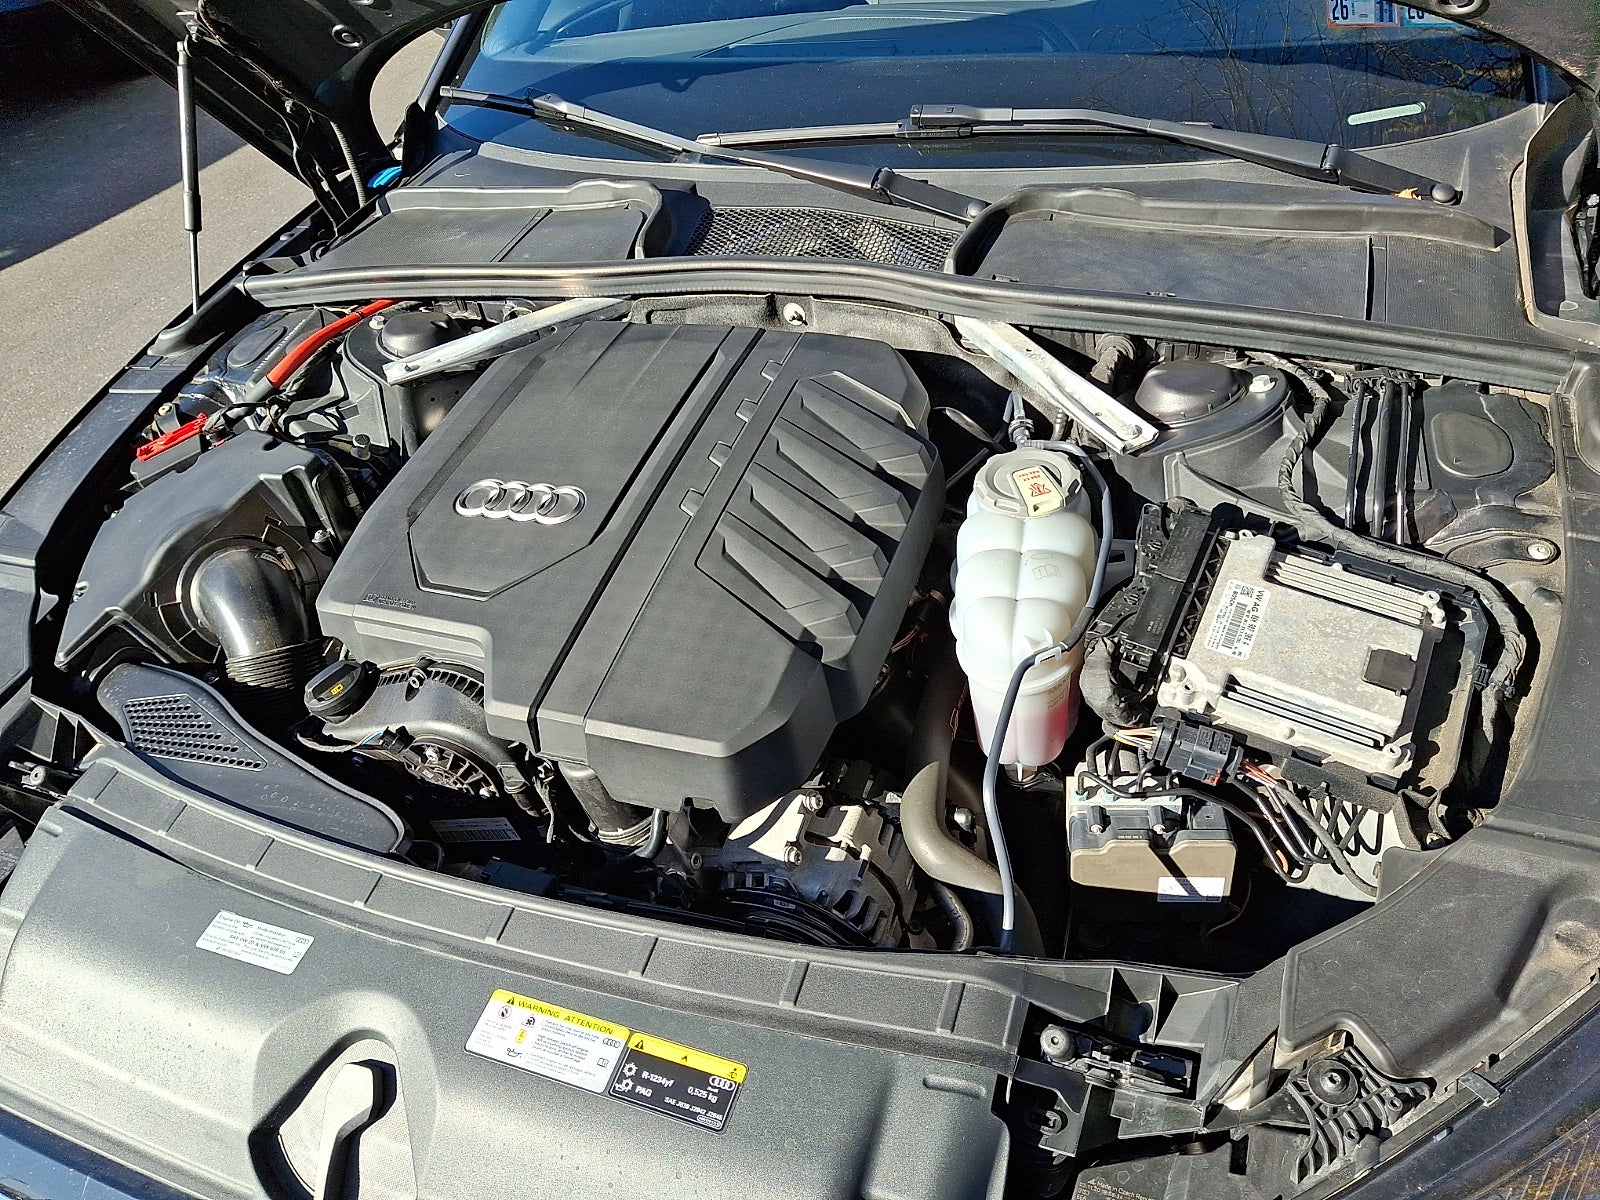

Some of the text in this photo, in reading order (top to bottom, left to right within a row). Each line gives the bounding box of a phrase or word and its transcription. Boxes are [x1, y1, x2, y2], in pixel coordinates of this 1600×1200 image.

[1332, 0, 1349, 20] 26
[1255, 590, 1265, 602] VW
[1251, 601, 1260, 613] AG
[518, 1000, 560, 1019] WARNING
[564, 1015, 613, 1035] ATTENTION
[641, 1070, 675, 1088] R-1234yf
[634, 1085, 653, 1097] PAG
[687, 1086, 718, 1103] 0,525 kg
[664, 1096, 677, 1105] SAE
